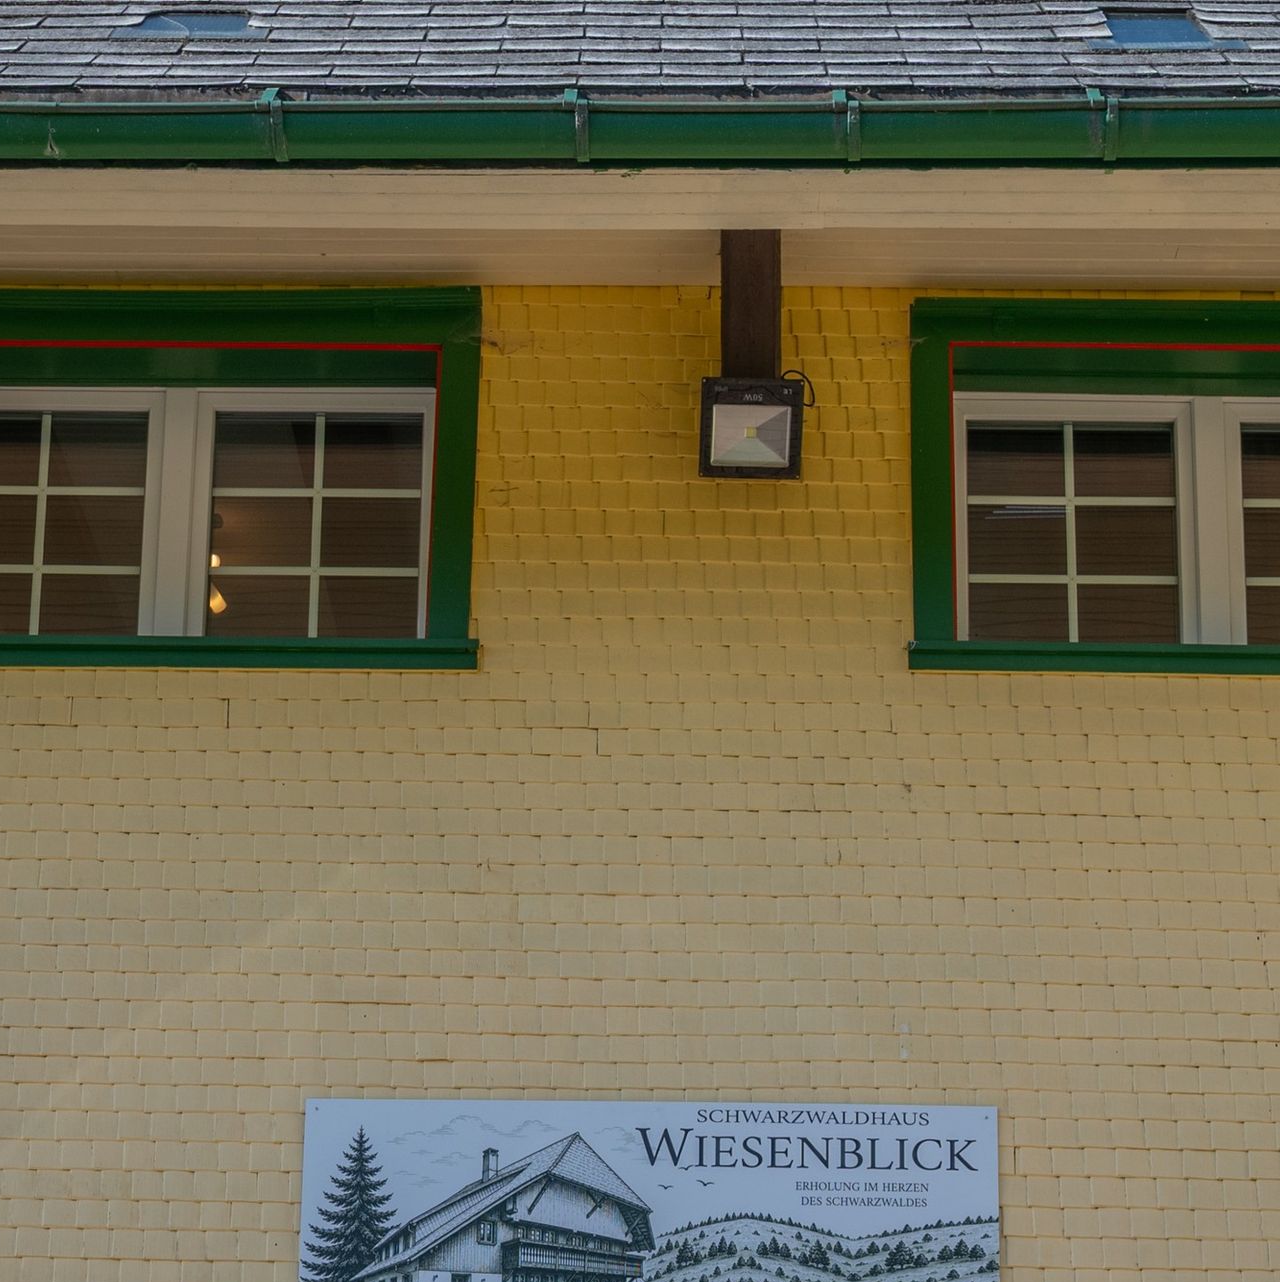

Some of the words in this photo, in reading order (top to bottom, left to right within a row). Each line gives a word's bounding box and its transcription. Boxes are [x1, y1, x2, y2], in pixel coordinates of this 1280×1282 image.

[743, 393, 763, 401] 50W
[696, 1109, 930, 1126] SCHWARZWALDHAUS
[635, 1127, 979, 1172] WIESENBLICK
[795, 1181, 860, 1192] ERHOLUNG
[864, 1182, 879, 1192] IM
[882, 1183, 929, 1193] HERZEN
[801, 1196, 823, 1206] DES
[825, 1196, 928, 1208] SCHWARZWALDES
